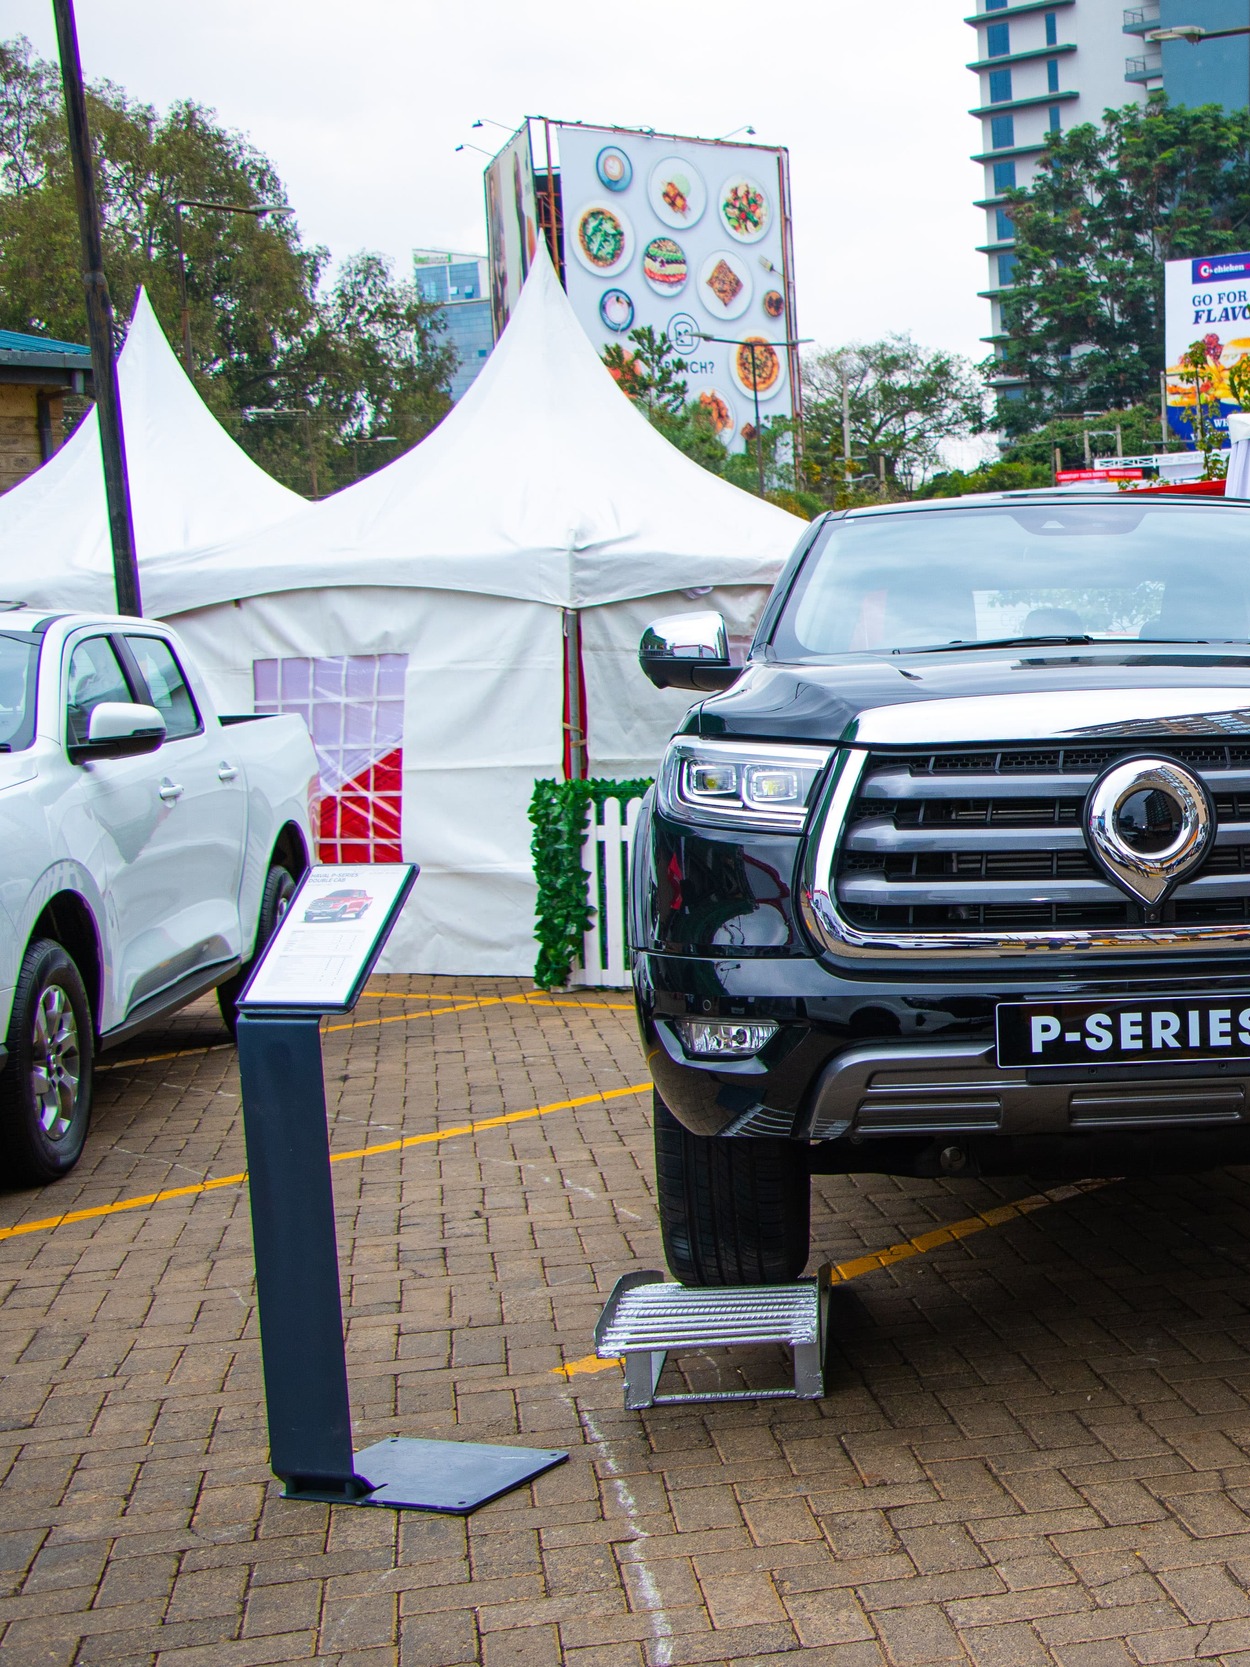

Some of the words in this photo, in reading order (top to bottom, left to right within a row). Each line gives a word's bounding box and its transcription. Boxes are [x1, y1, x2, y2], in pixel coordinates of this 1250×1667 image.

[1214, 263, 1245, 273] chicken
[1192, 294, 1212, 307] GO
[1217, 290, 1247, 304] FOR
